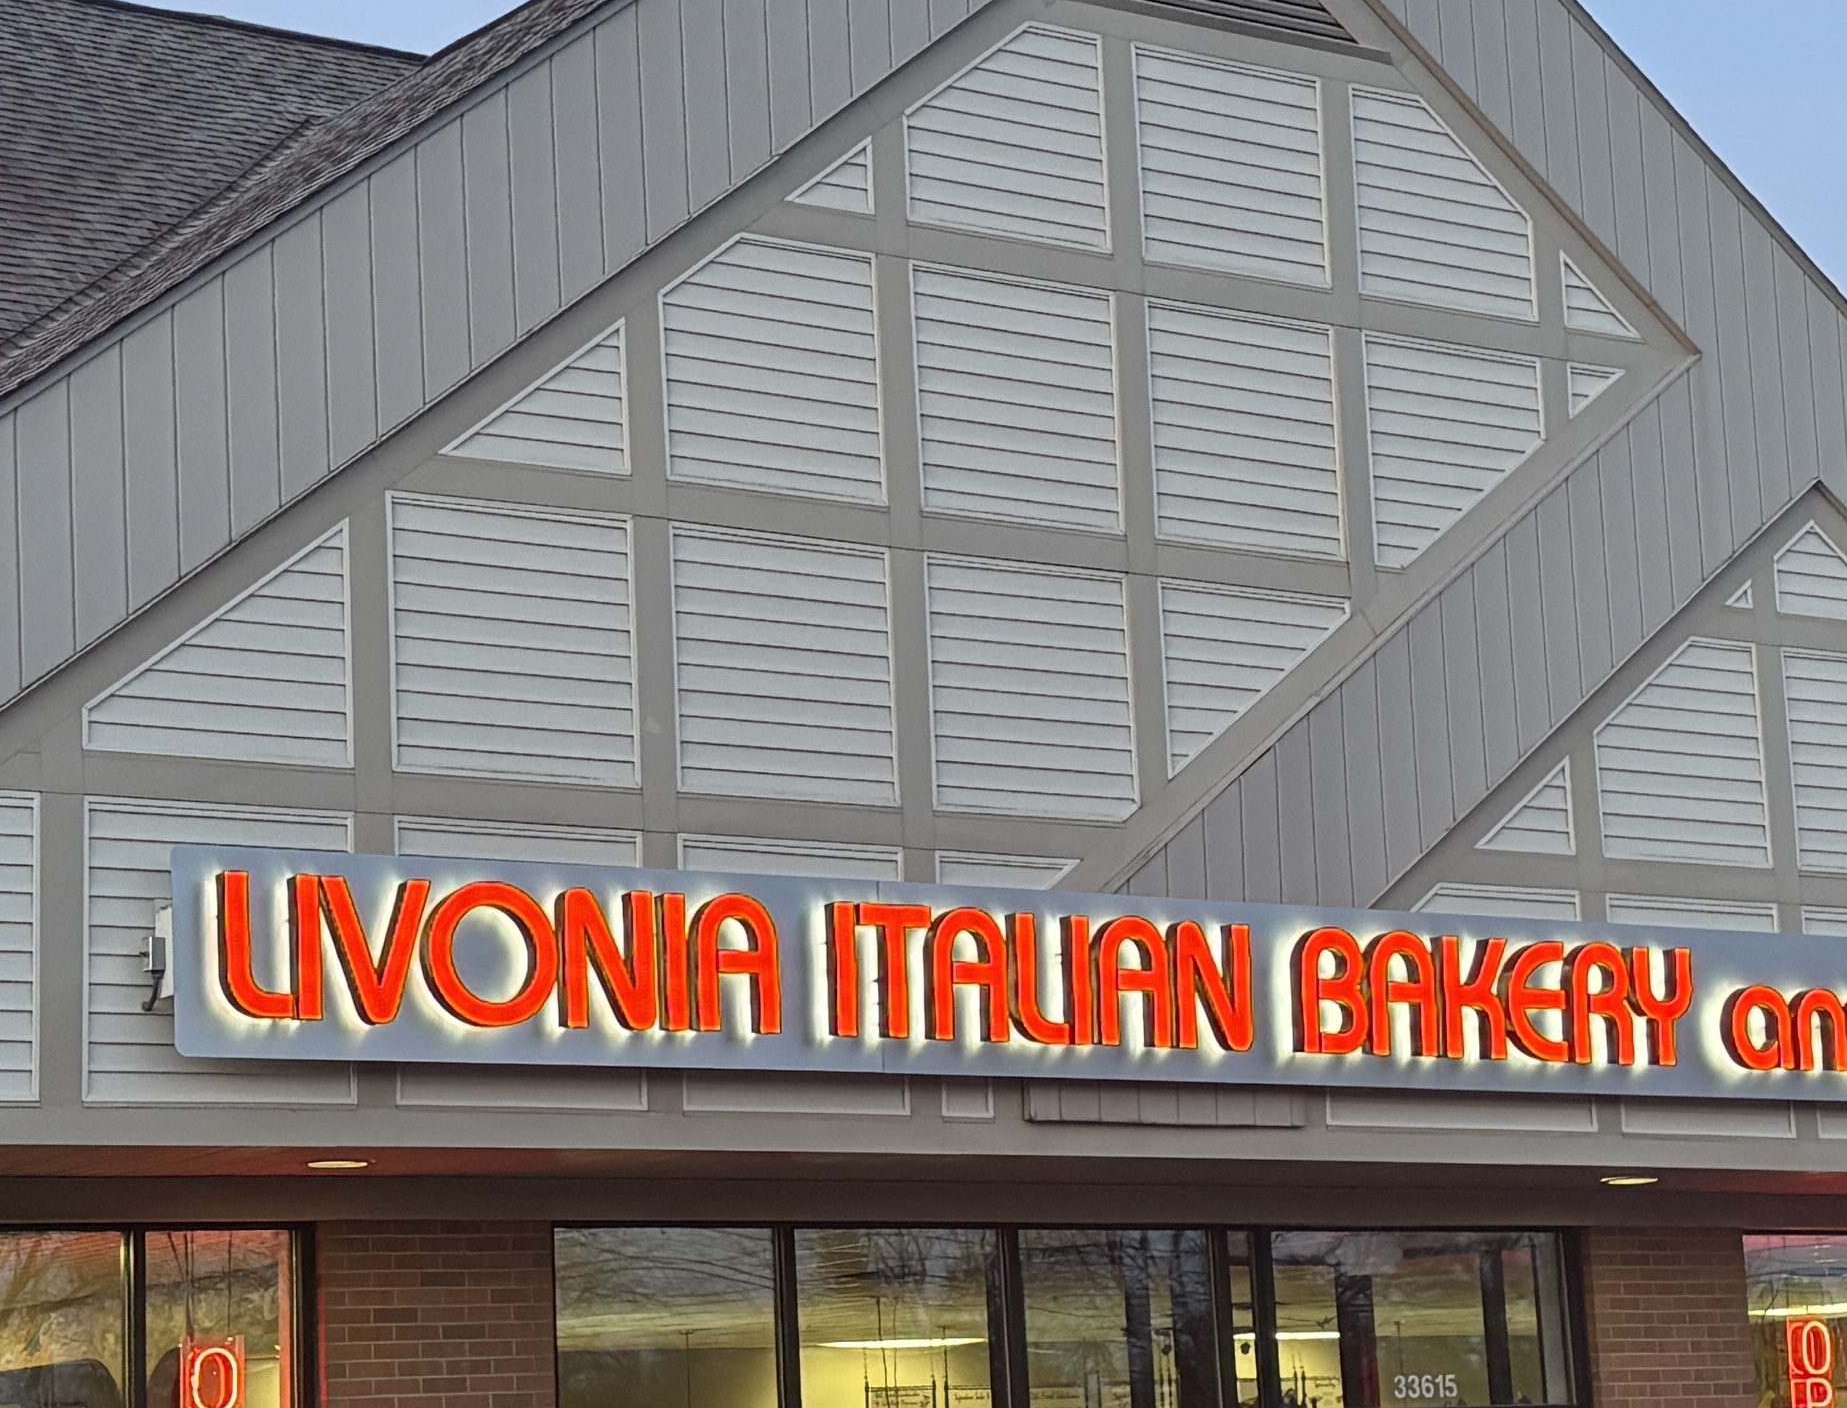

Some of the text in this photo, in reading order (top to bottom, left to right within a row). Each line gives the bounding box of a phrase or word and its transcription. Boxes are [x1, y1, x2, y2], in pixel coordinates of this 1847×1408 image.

[215, 869, 783, 1034] LIVONIA
[825, 899, 1255, 1053] ITALIAN
[1291, 926, 1694, 1067] BAKERY
[1394, 1374, 1458, 1399] 33615
